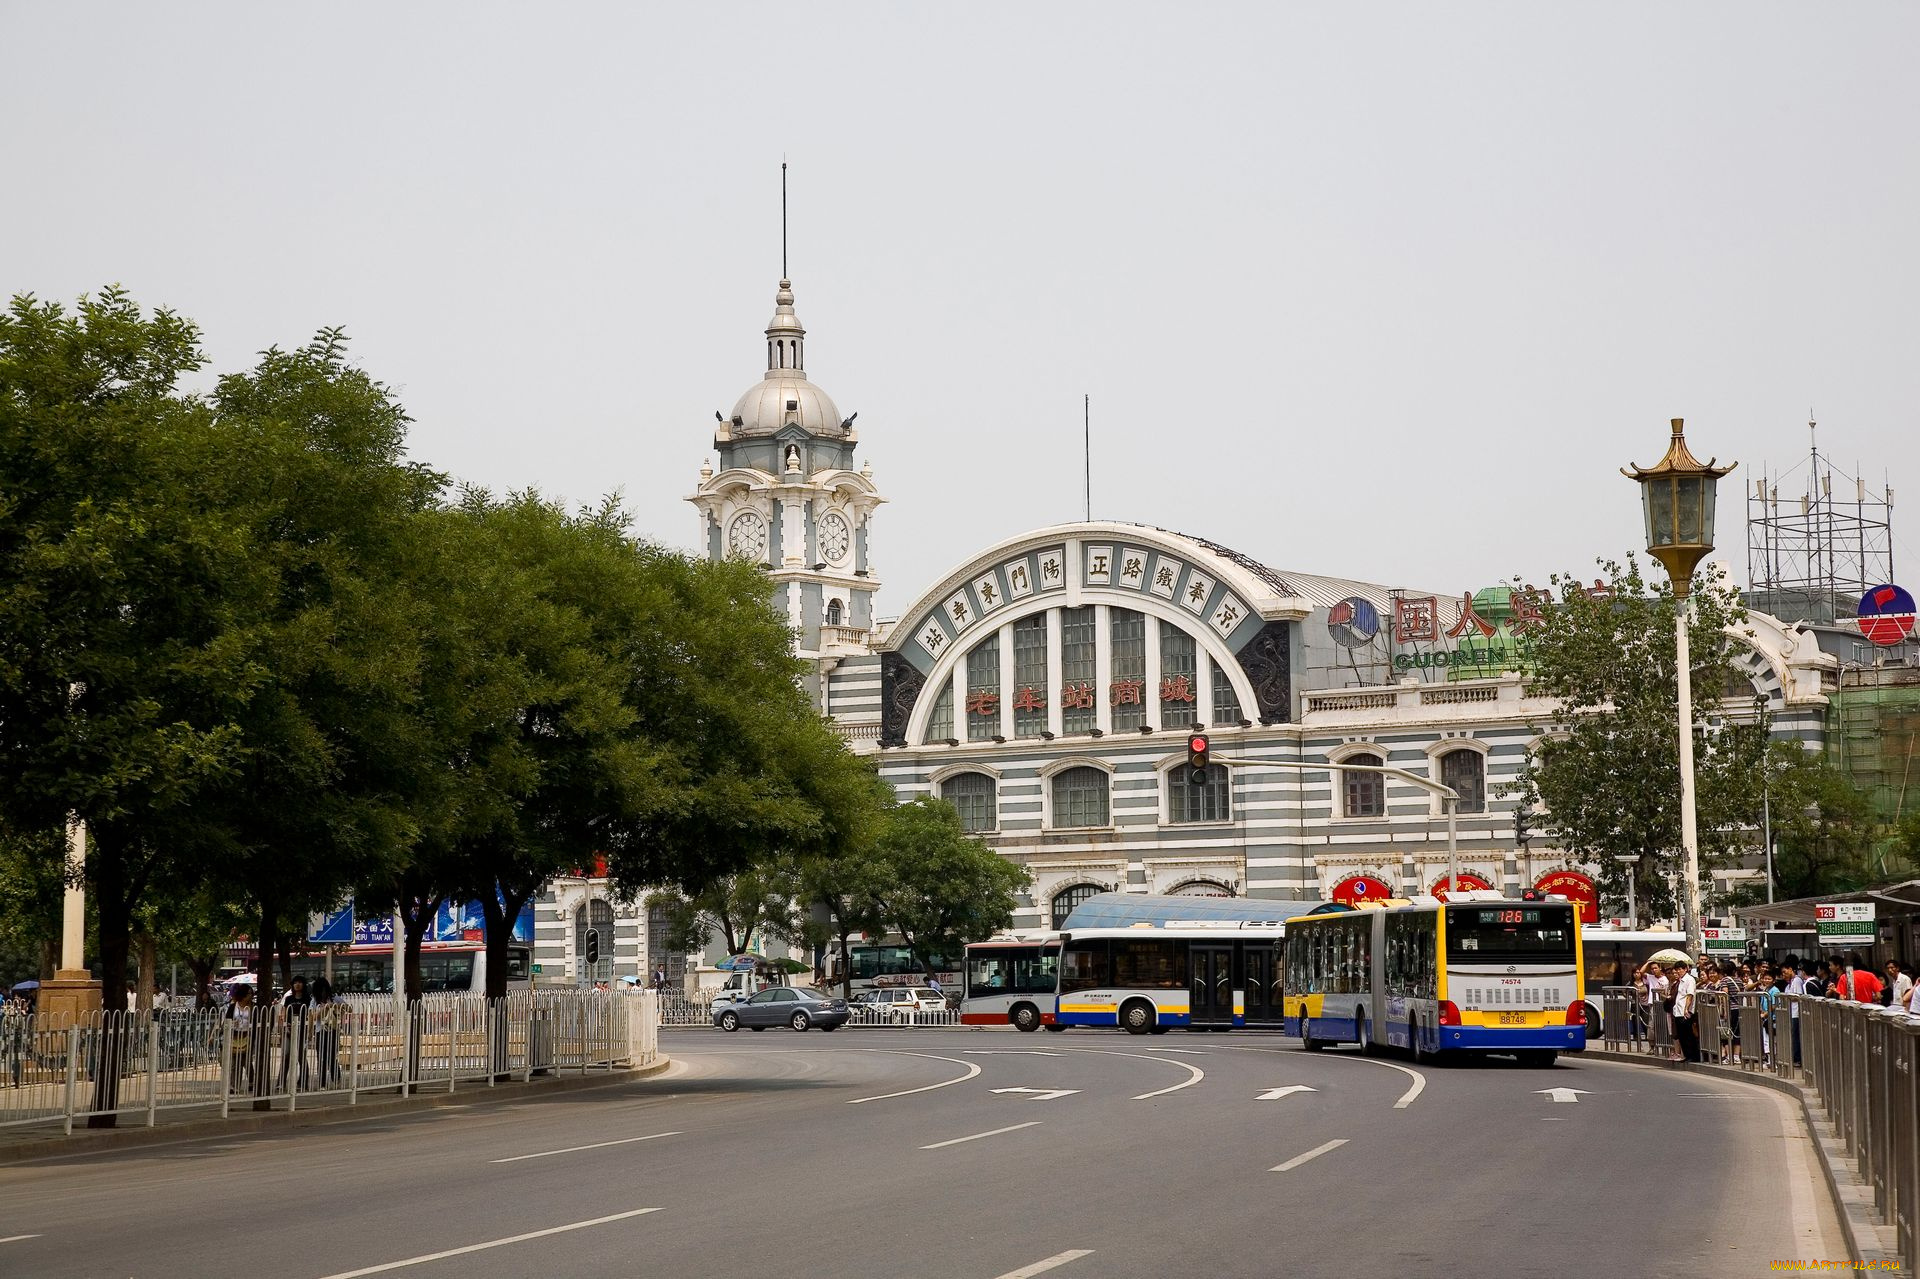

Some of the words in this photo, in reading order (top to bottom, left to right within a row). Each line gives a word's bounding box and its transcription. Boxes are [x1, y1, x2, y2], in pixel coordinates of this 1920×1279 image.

[1394, 647, 1506, 670] GUOREN
[965, 675, 1195, 717] 老车站商城
[1500, 911, 1523, 923] 126
[1819, 908, 1834, 917] 126
